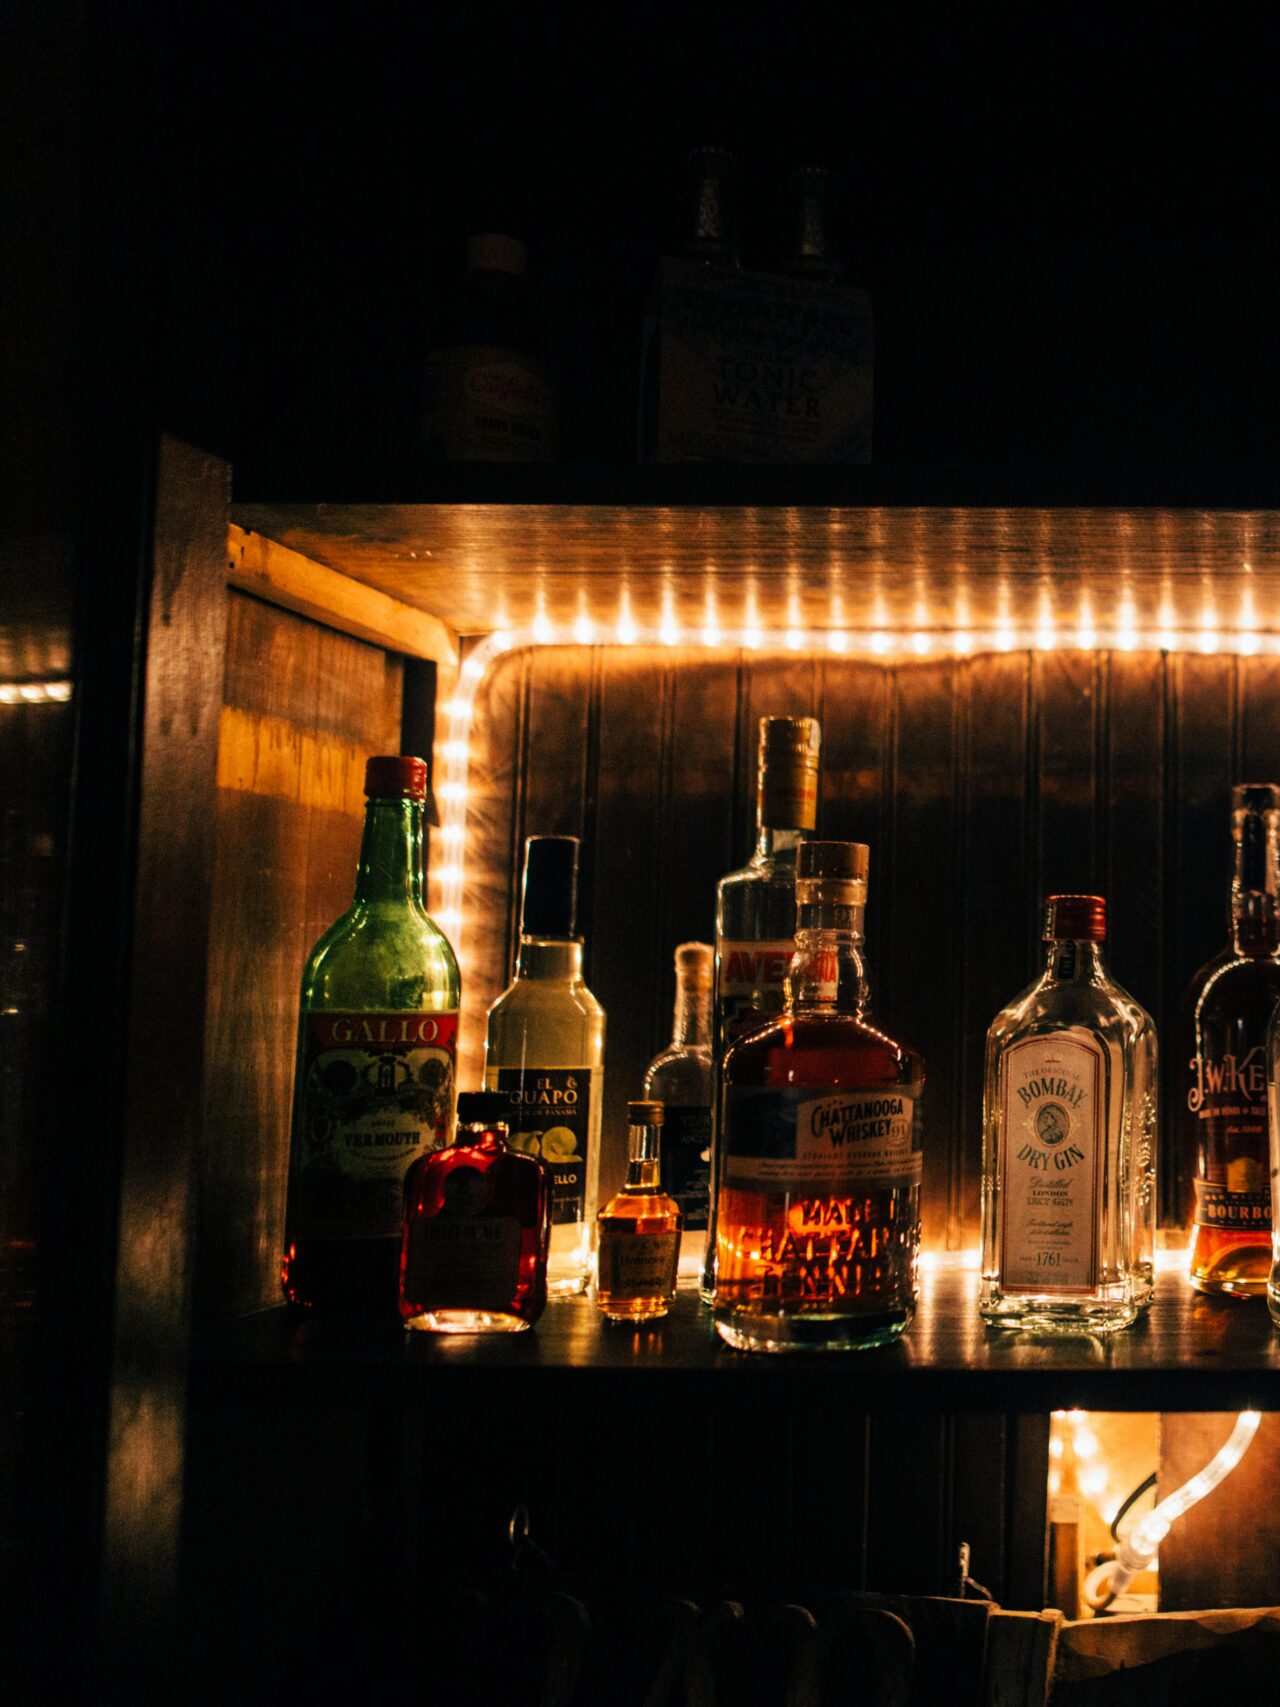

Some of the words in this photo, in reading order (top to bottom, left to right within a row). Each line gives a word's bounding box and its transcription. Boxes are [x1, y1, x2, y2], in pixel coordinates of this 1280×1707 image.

[716, 357, 820, 394] TONIC
[713, 383, 822, 420] WATER
[331, 1018, 439, 1043] GALLO
[537, 1077, 553, 1090] EL
[1016, 1077, 1088, 1109] BOMBAY
[810, 1098, 904, 1138] CHATTANOOGA
[344, 1131, 420, 1149] VERMOUTH
[829, 1118, 894, 1149] WHISKEY
[1016, 1144, 1050, 1172] DRY
[1053, 1144, 1086, 1172] GIN
[553, 1173, 578, 1185] ELLO
[1207, 1203, 1271, 1220] BOURBO
[1036, 1251, 1062, 1267] 1761
